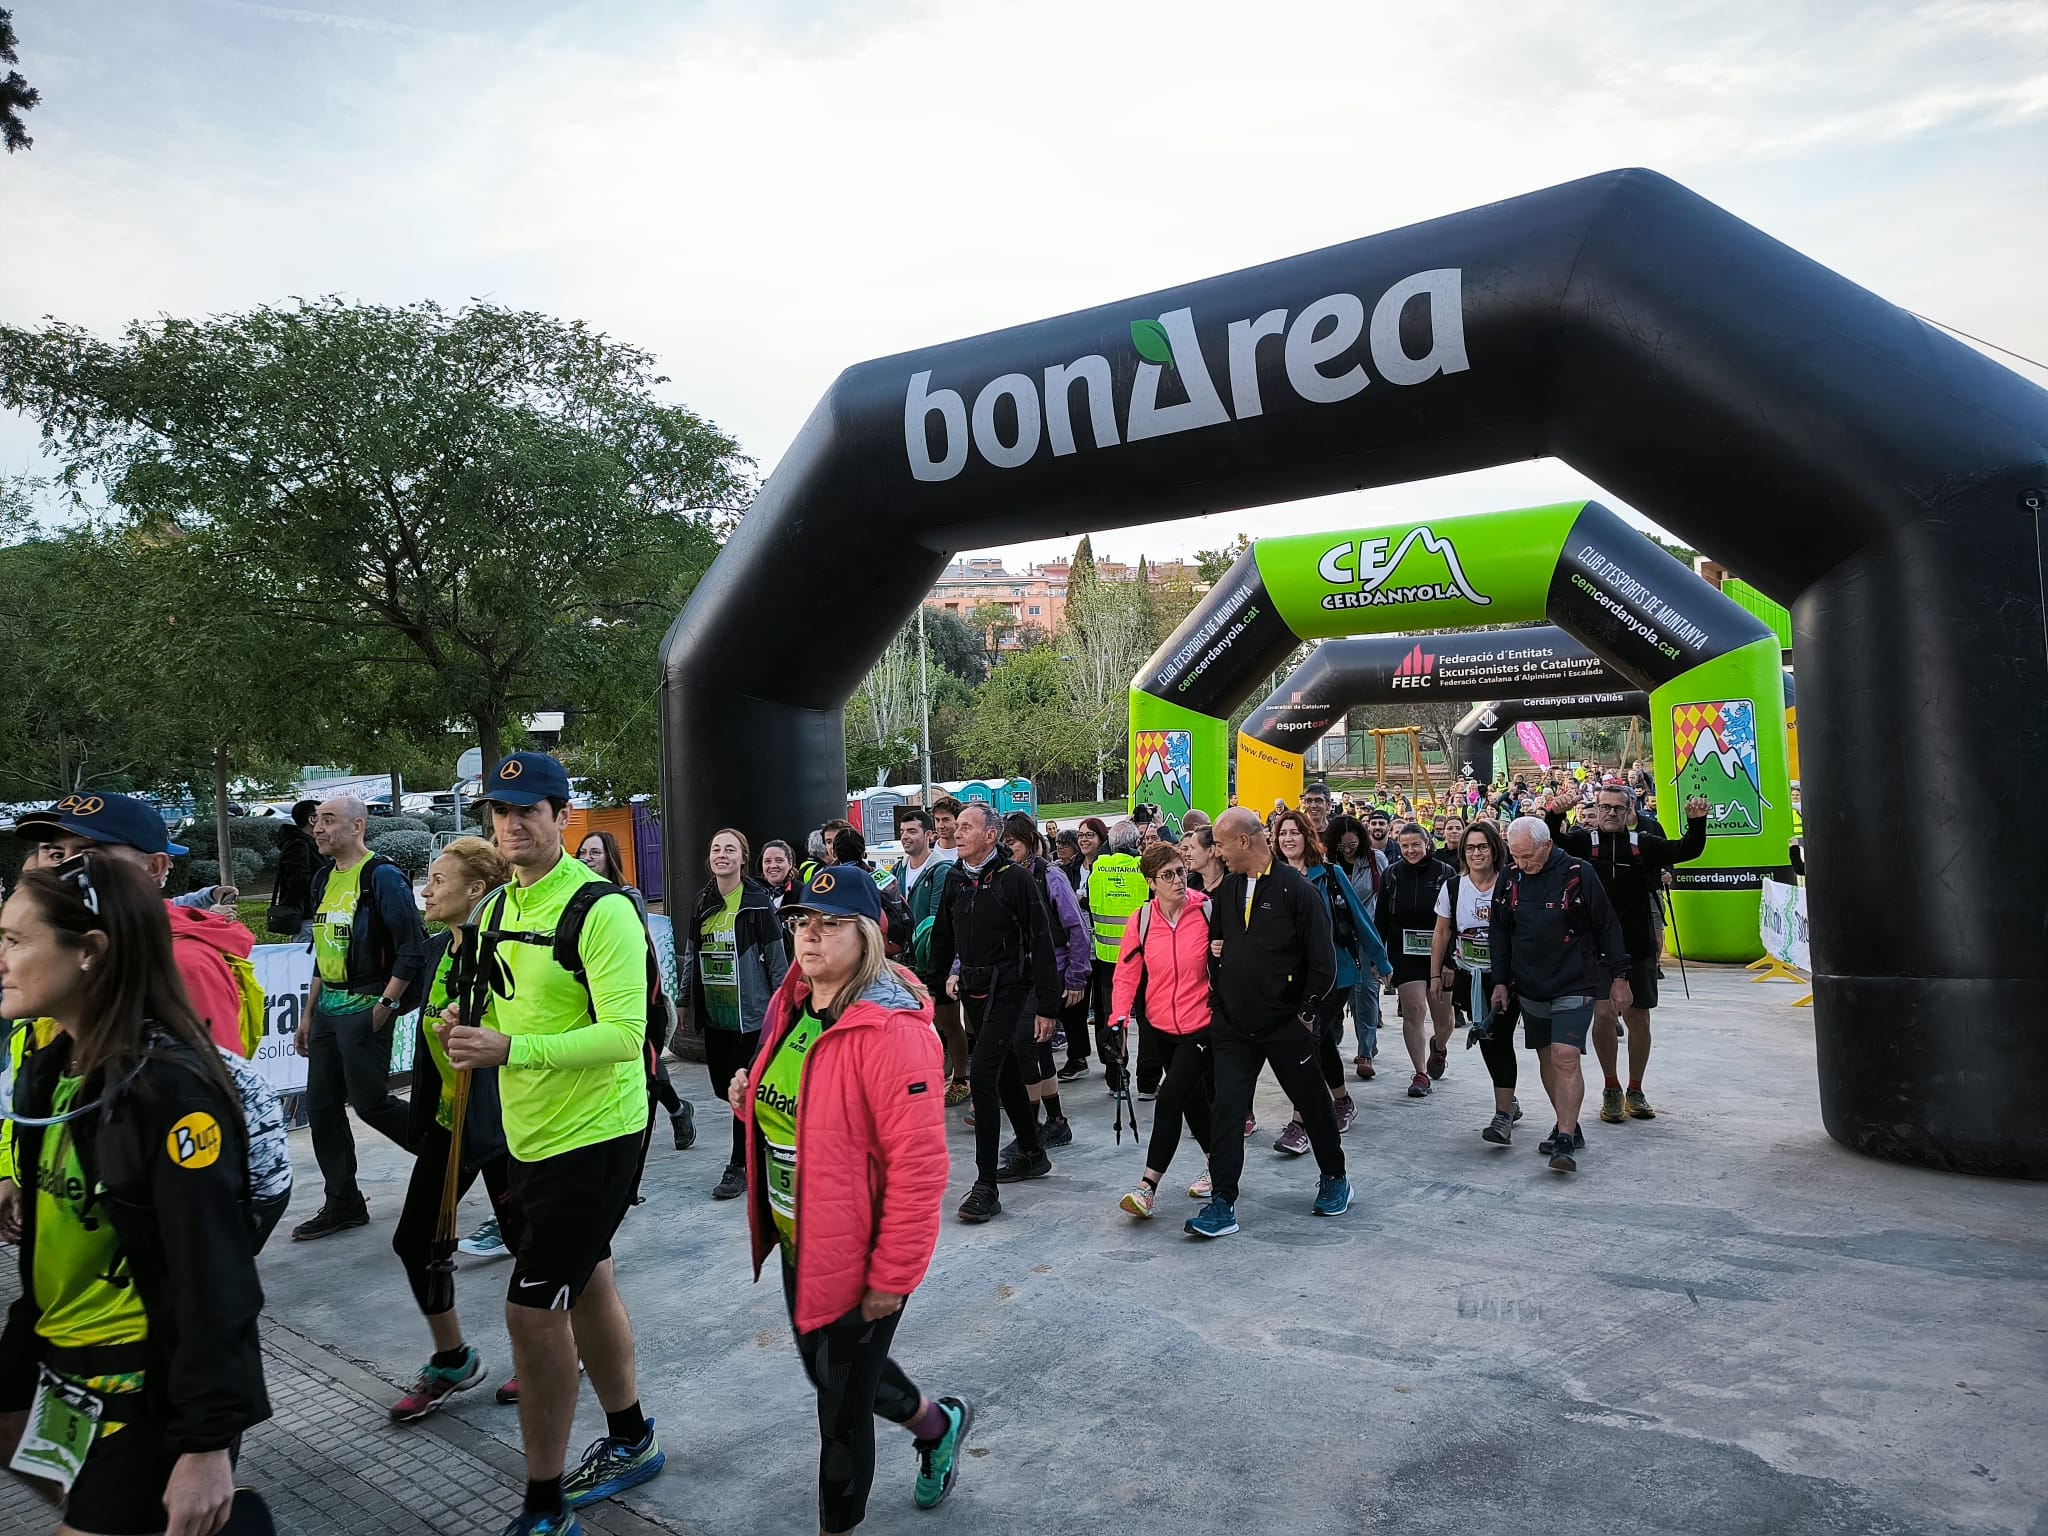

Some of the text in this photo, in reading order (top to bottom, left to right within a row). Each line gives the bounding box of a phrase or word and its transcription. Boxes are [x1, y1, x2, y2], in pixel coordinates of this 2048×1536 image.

[904, 268, 1470, 482] bonArea
[1317, 525, 1493, 606] CEM
[1321, 583, 1464, 610] CERDANYOLA
[1577, 545, 1710, 651] CLUB D'ESPORTS DE MUNTANYA
[1571, 573, 1681, 660] cemcerdanyola.cat
[1158, 584, 1254, 686] CLUB D'ESPORTS DE MUNTANYA
[1178, 605, 1261, 692] cemcerdanyola.cat
[1439, 651, 1494, 665] Federació
[1439, 657, 1601, 678] Excursionistes de Catalunya
[1440, 677, 1477, 687] Federació
[1478, 675, 1513, 684] Catalana
[1568, 667, 1604, 677] Escalada
[1392, 675, 1432, 689] FEEC
[1523, 692, 1624, 707] Cerdanyola del Vallès
[1276, 719, 1329, 733] esportcat
[1474, 948, 1487, 957] 50
[713, 962, 724, 972] 47
[263, 983, 310, 1036] rai
[258, 1039, 296, 1060] solid
[757, 1083, 798, 1117] abad
